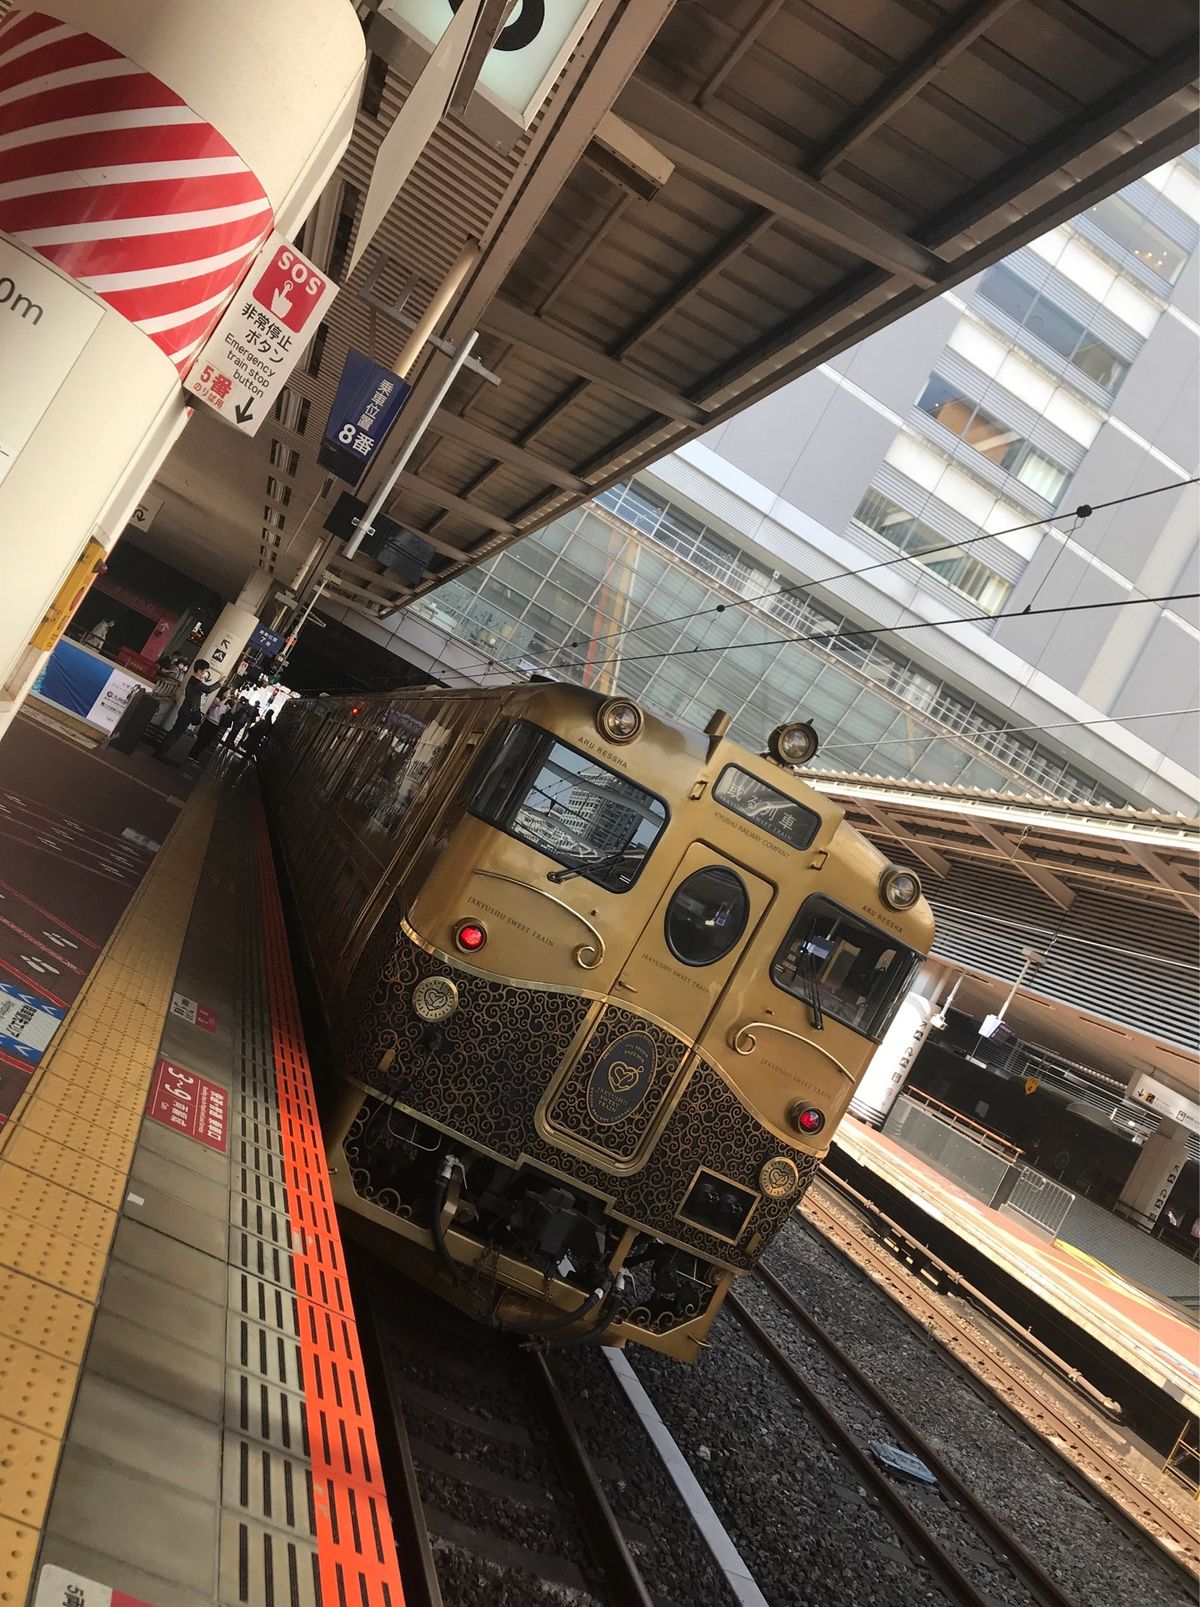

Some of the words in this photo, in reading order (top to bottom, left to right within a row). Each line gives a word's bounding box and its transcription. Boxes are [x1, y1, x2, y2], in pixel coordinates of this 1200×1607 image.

[278, 252, 321, 295] SOS
[241, 302, 293, 352] 非常停止
[224, 332, 276, 377] Emergency
[245, 328, 284, 363] ボタン
[200, 364, 233, 400] 5番
[227, 350, 249, 375] train
[250, 367, 270, 388] stop
[232, 369, 265, 398] button
[193, 381, 225, 409] のりば用
[357, 379, 394, 431] 乗車位置
[338, 423, 375, 456] 8番
[578, 736, 595, 750] ARU
[596, 746, 628, 768] RESSHA
[727, 782, 797, 831] 或る列車
[714, 811, 737, 829] KYUSHU
[738, 824, 762, 842] RAILWAY
[762, 839, 791, 858] COMPANY
[507, 918, 530, 934] SWEET
[532, 931, 555, 947] TRAIN
[862, 904, 877, 917] ARU
[876, 913, 903, 933] RESSHA
